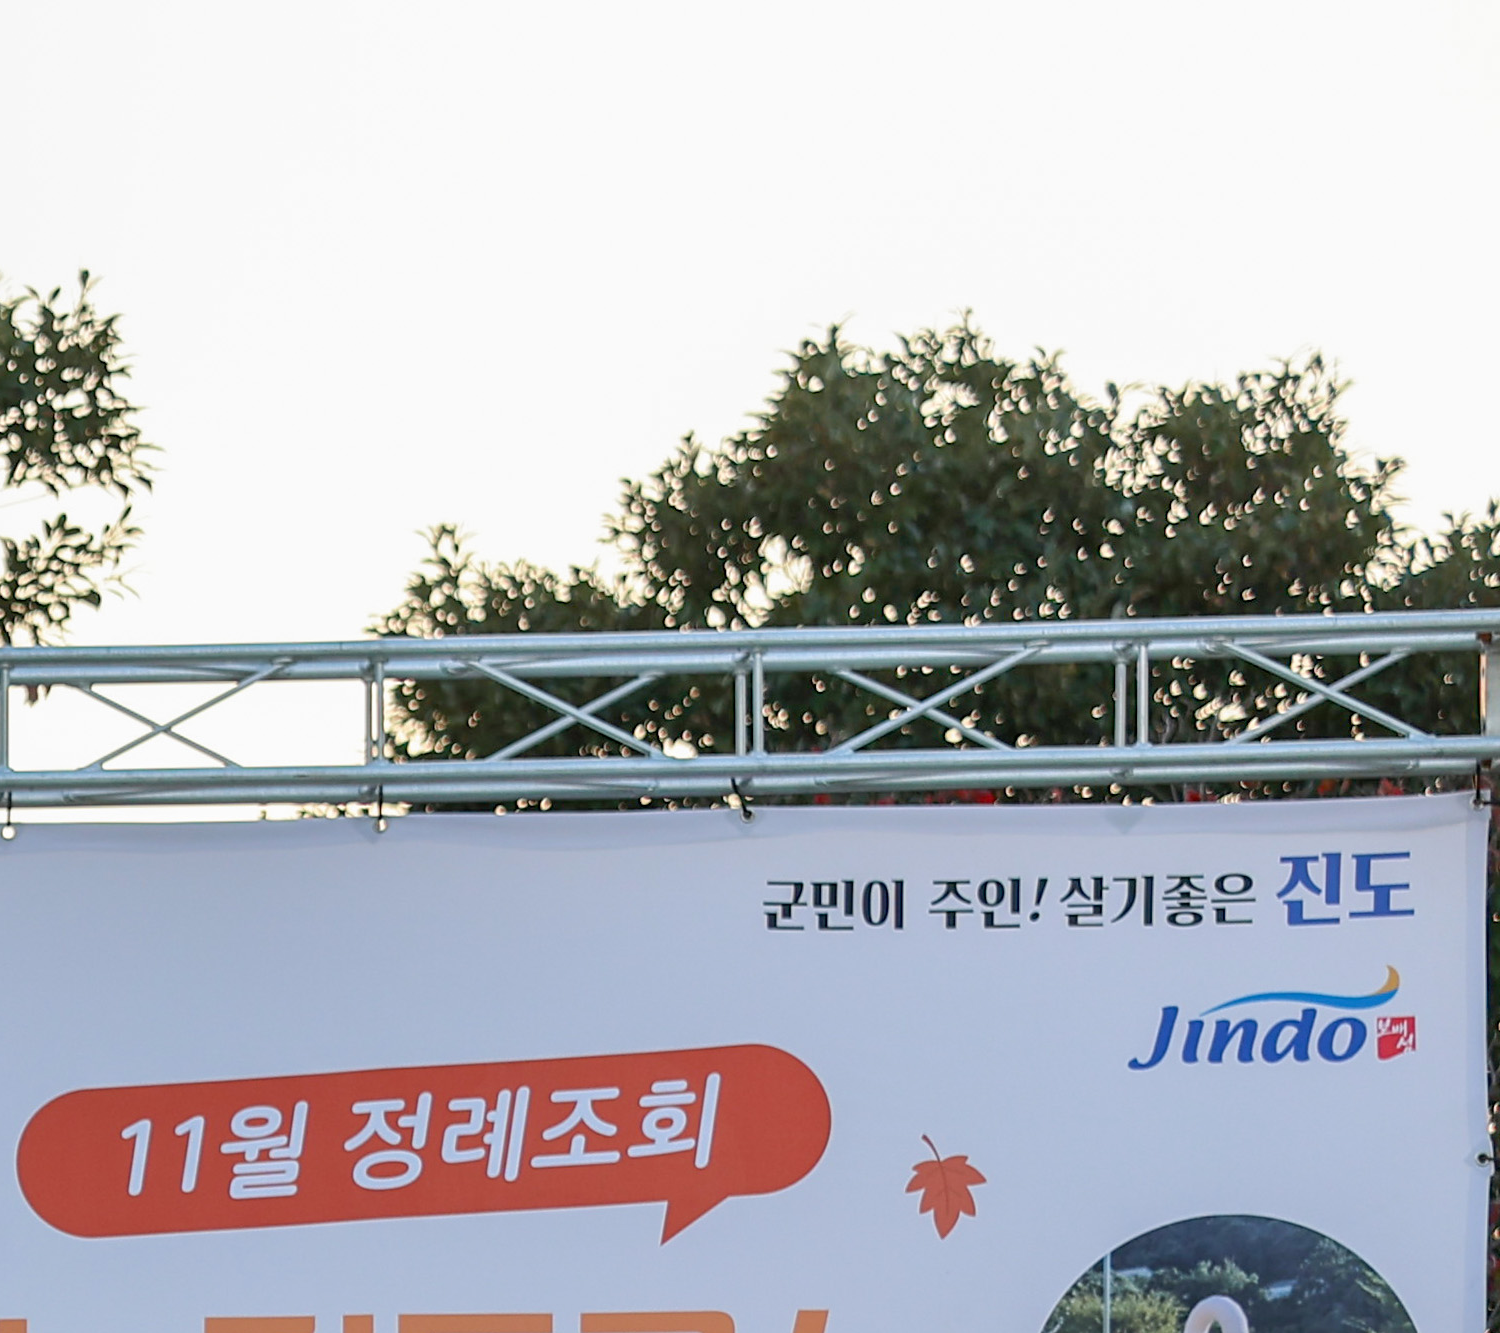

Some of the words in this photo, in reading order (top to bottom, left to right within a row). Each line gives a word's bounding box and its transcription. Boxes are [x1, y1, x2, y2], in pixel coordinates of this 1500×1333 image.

[762, 879, 905, 931] 군민이
[928, 876, 1048, 930] 주인!
[1059, 873, 1257, 928] 살기좋은
[1276, 851, 1415, 926] 진도
[1128, 1005, 1367, 1070] Jindo
[120, 1100, 309, 1200] 11월
[344, 1072, 721, 1191] 정례조회
